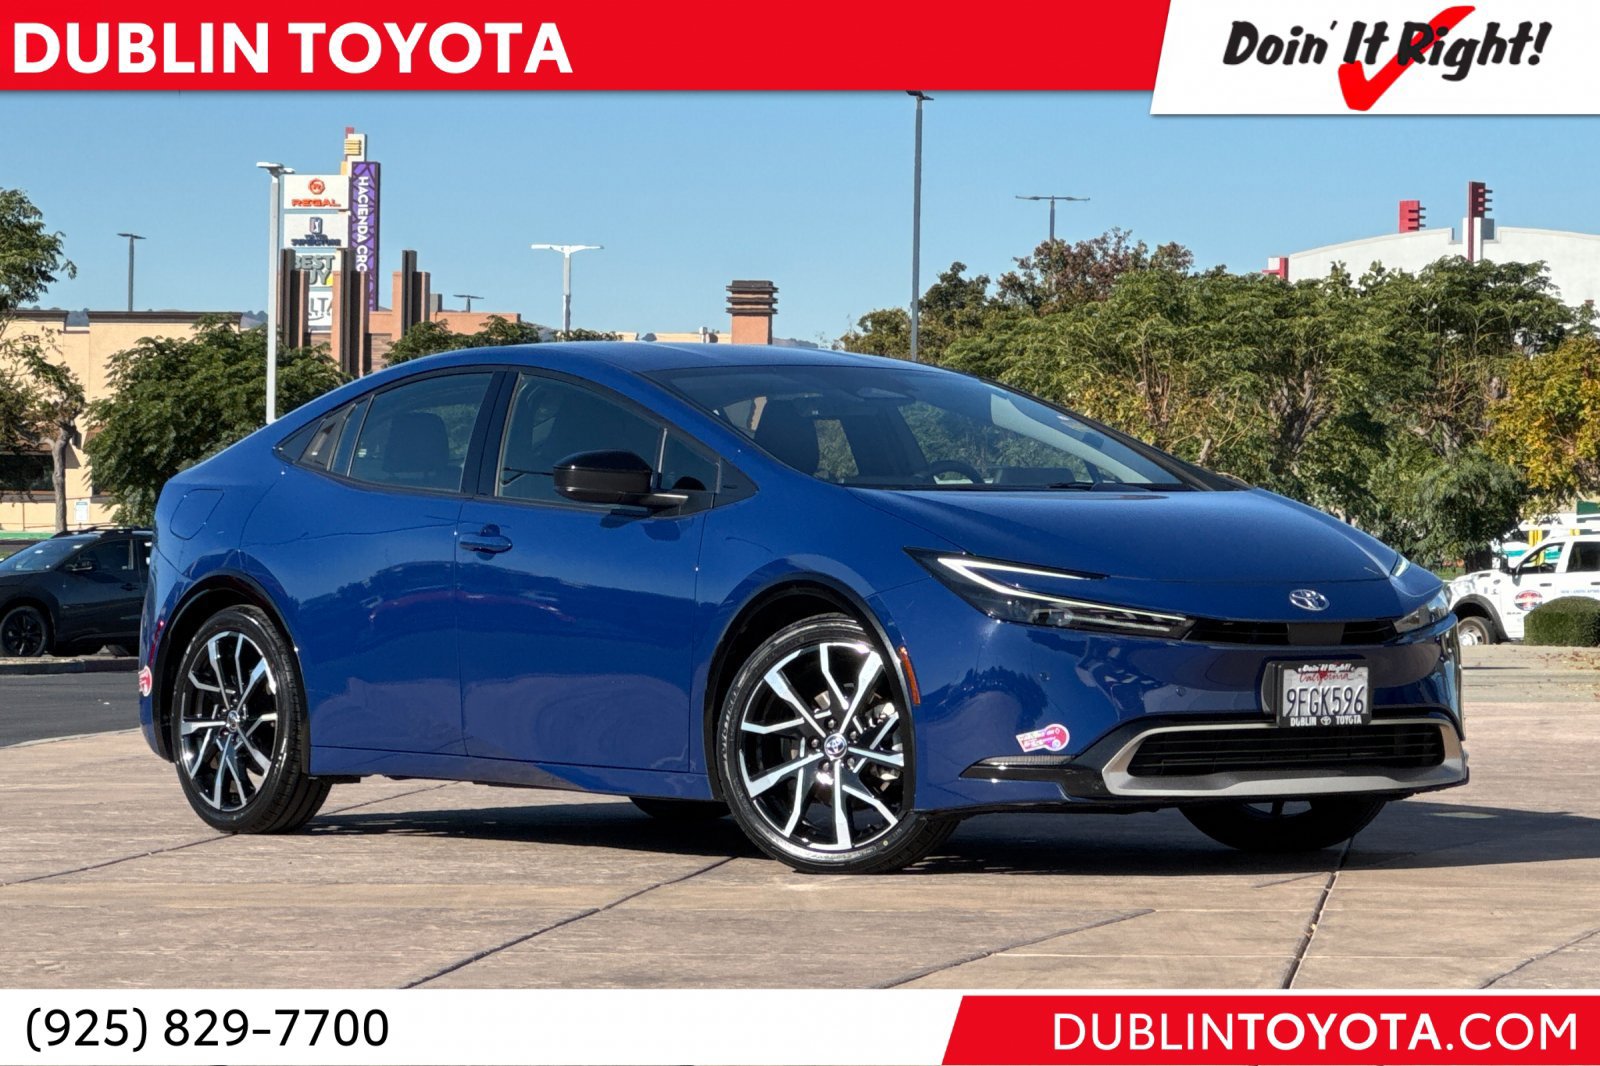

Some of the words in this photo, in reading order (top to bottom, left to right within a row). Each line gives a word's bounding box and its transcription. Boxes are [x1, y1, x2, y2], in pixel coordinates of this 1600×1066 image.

[357, 176, 368, 243] HACIENDA
[1286, 686, 1365, 717] 9FGK596
[1290, 716, 1317, 727] DUBLIN
[1335, 714, 1362, 725] TOYOTA
